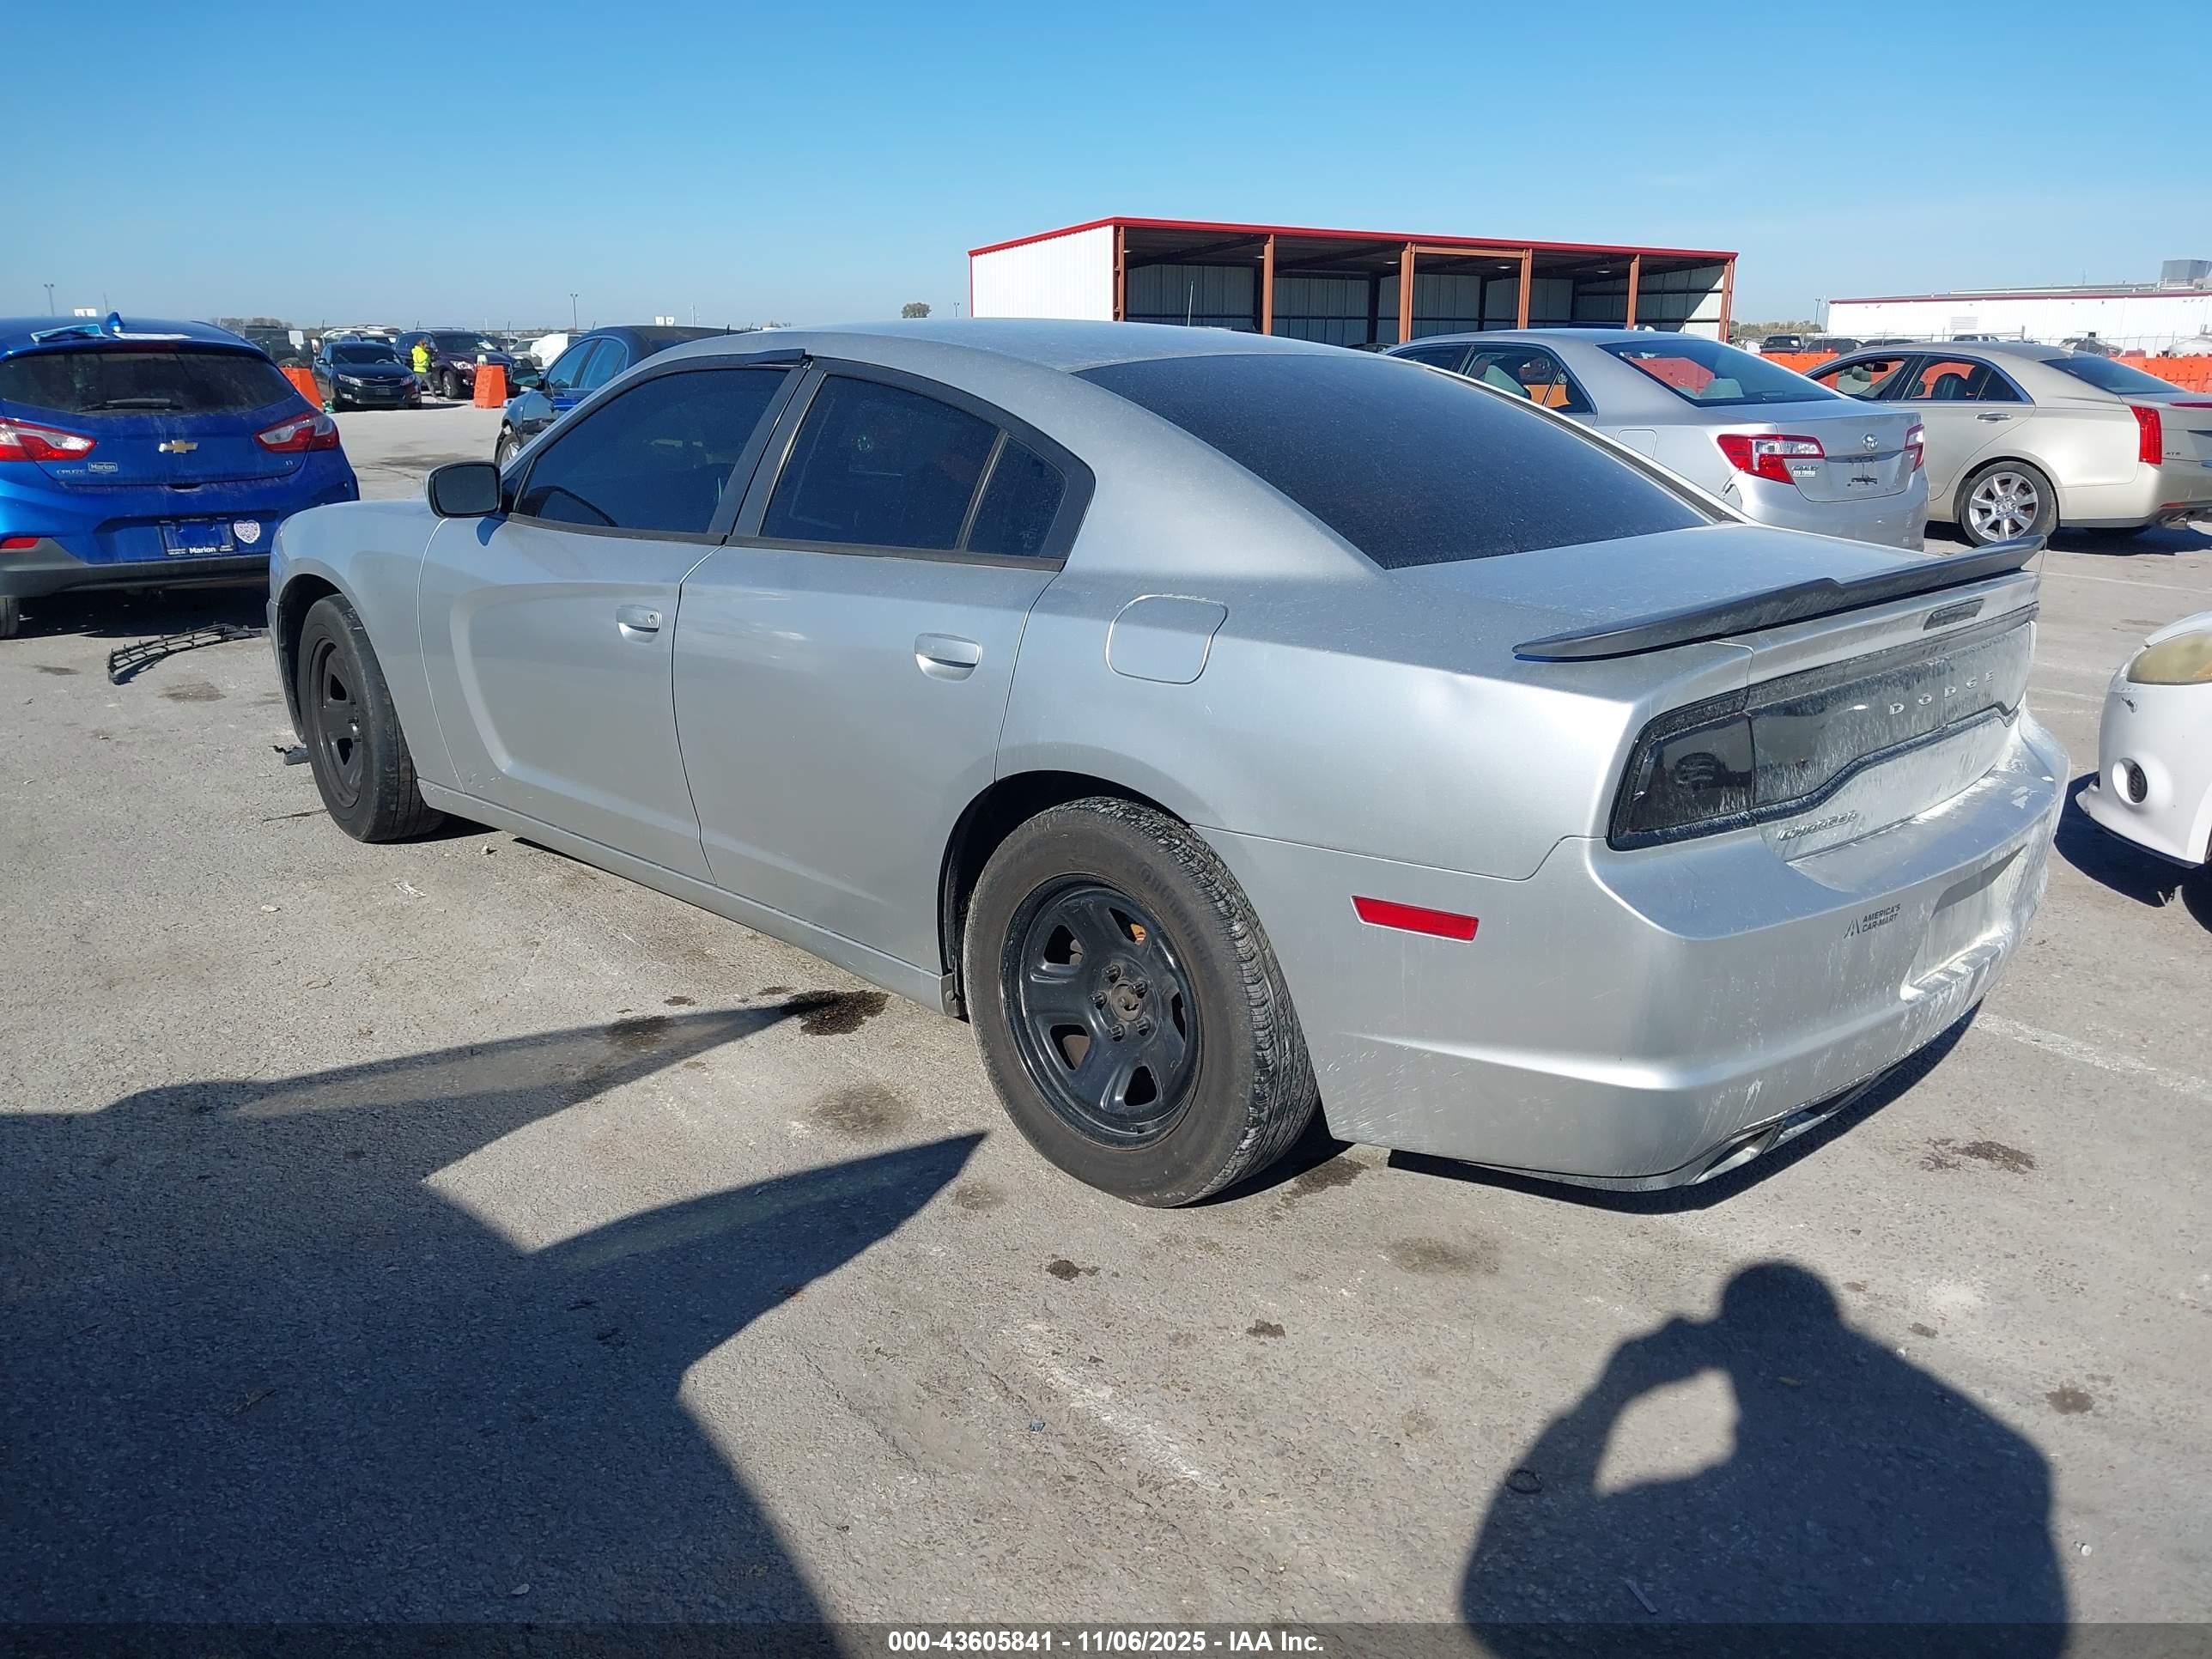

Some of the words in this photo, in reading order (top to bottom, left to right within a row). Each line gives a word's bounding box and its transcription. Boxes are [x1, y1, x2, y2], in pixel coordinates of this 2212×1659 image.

[188, 545, 216, 554] Marion
[1889, 670, 1994, 715] DODGE
[1862, 902, 1901, 924] AMERICA'S
[1862, 913, 1899, 933] CAR-MART
